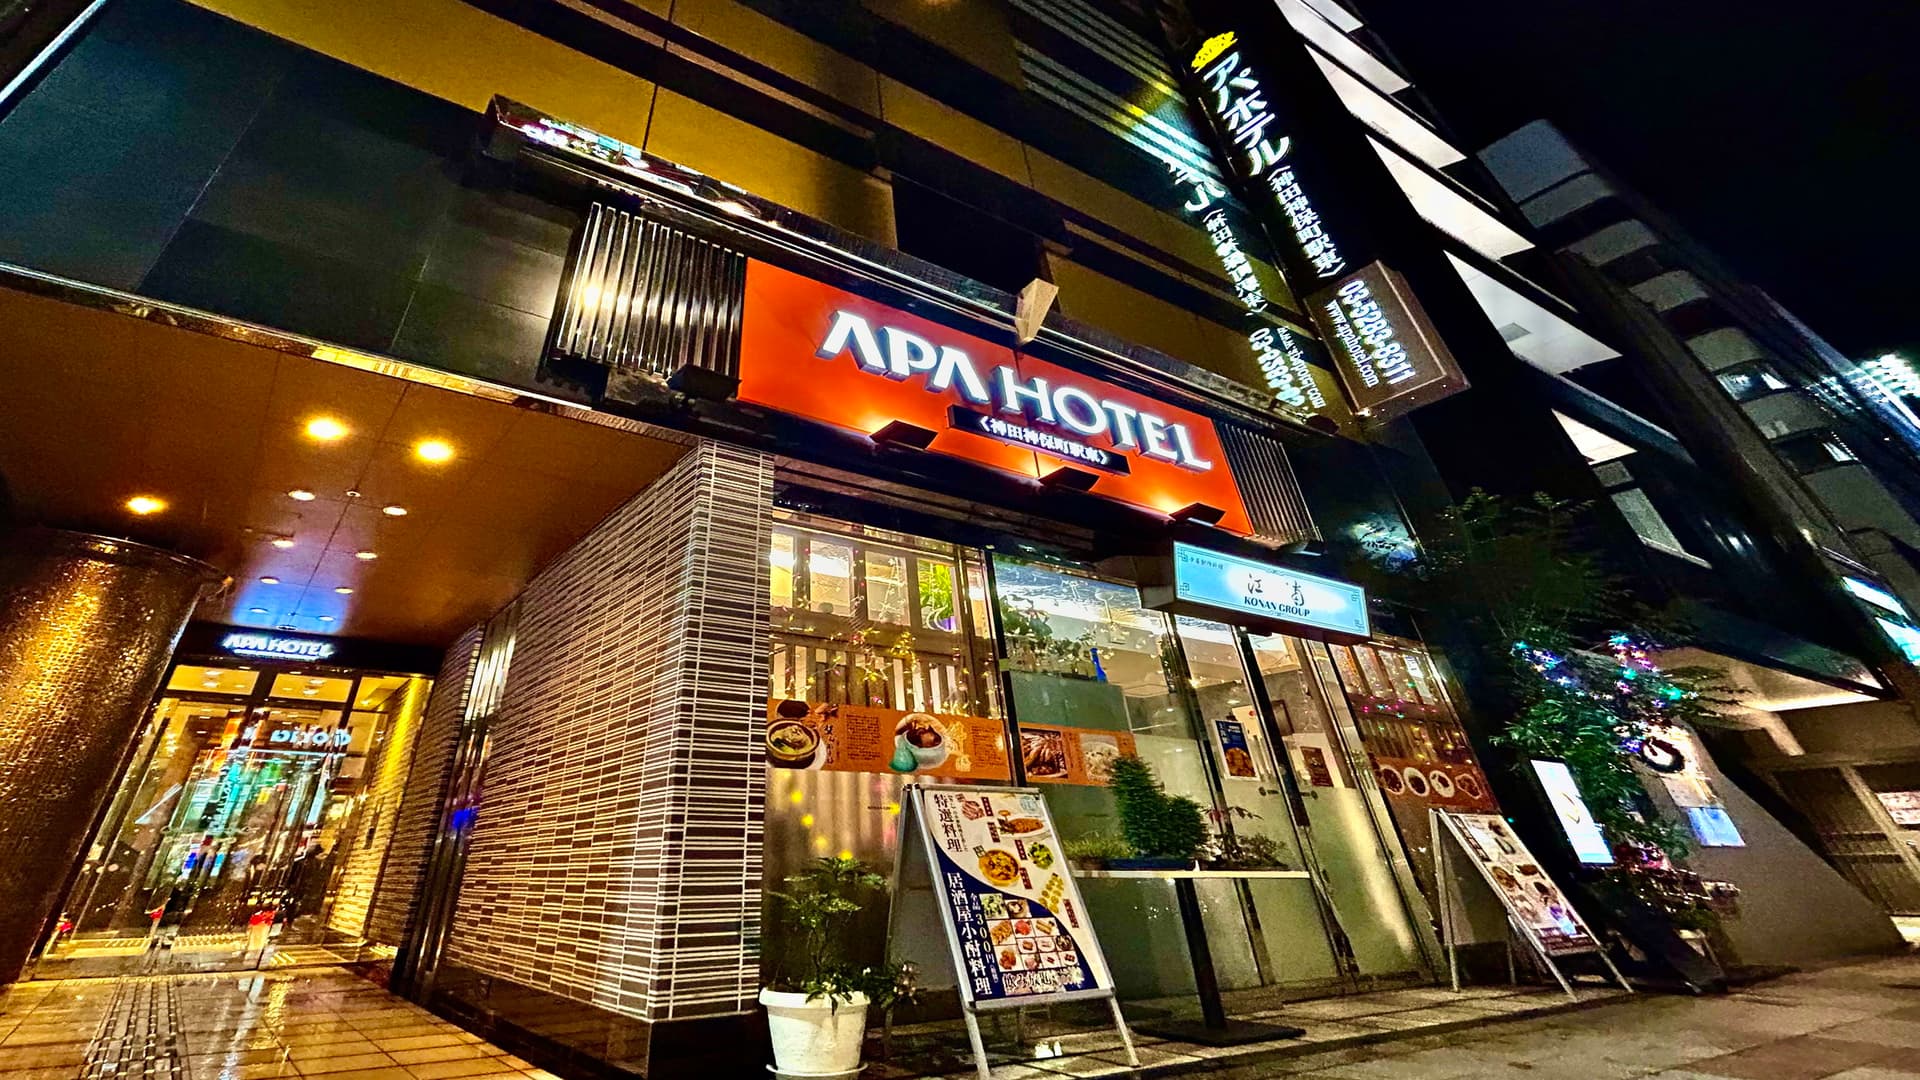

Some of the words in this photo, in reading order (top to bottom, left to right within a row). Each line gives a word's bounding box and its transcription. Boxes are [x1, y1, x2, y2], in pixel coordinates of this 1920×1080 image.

[1203, 51, 1290, 176] アパホテル
[1324, 299, 1379, 388] www.apahotel.com
[1337, 280, 1416, 384] 03-5283-8311
[818, 311, 990, 403] APA
[996, 366, 1212, 471] HOTEL
[222, 633, 266, 651] APA
[267, 638, 334, 657] HOTEL
[1244, 597, 1277, 611] KONAN
[1279, 603, 1310, 617] GROUP
[934, 793, 963, 852] 特選料理
